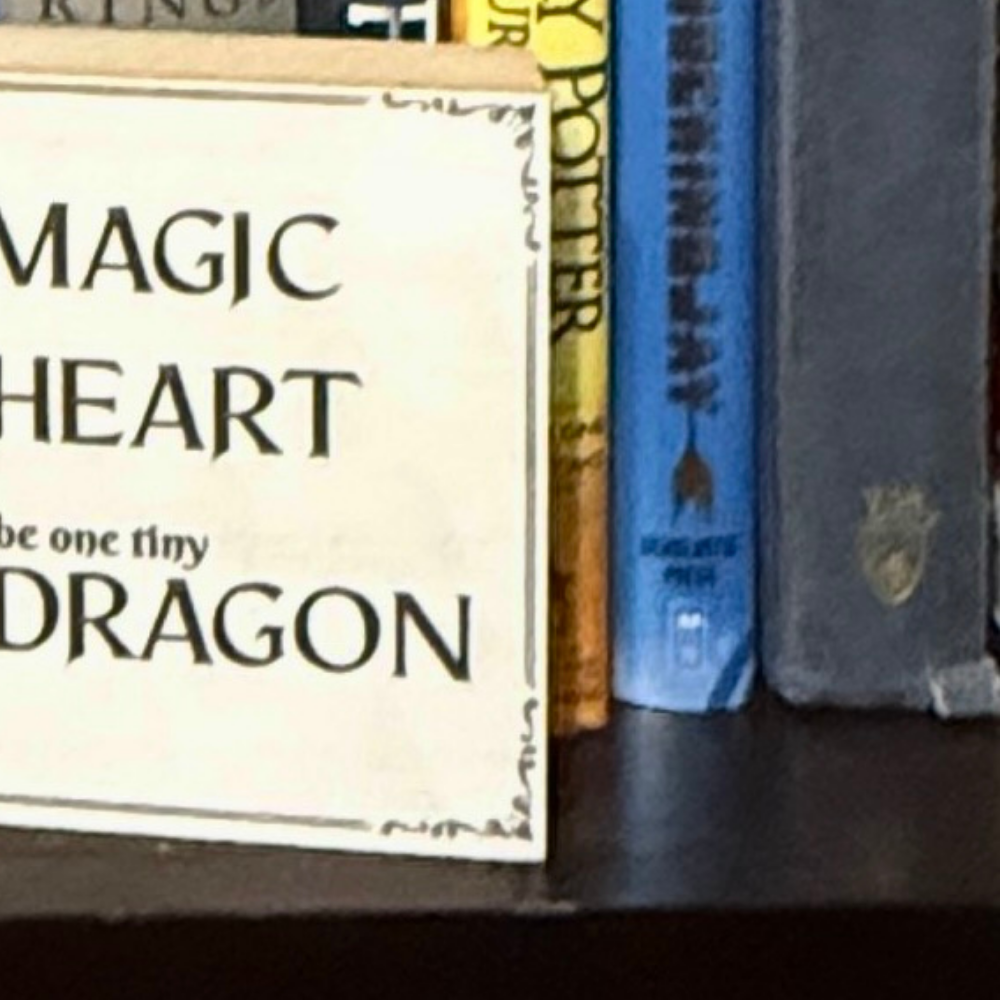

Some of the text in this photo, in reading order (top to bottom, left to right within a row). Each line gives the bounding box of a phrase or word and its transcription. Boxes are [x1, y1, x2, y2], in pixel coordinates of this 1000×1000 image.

[539, 62, 608, 347] POTTER
[48, 526, 118, 558] one
[131, 524, 209, 568] tiny
